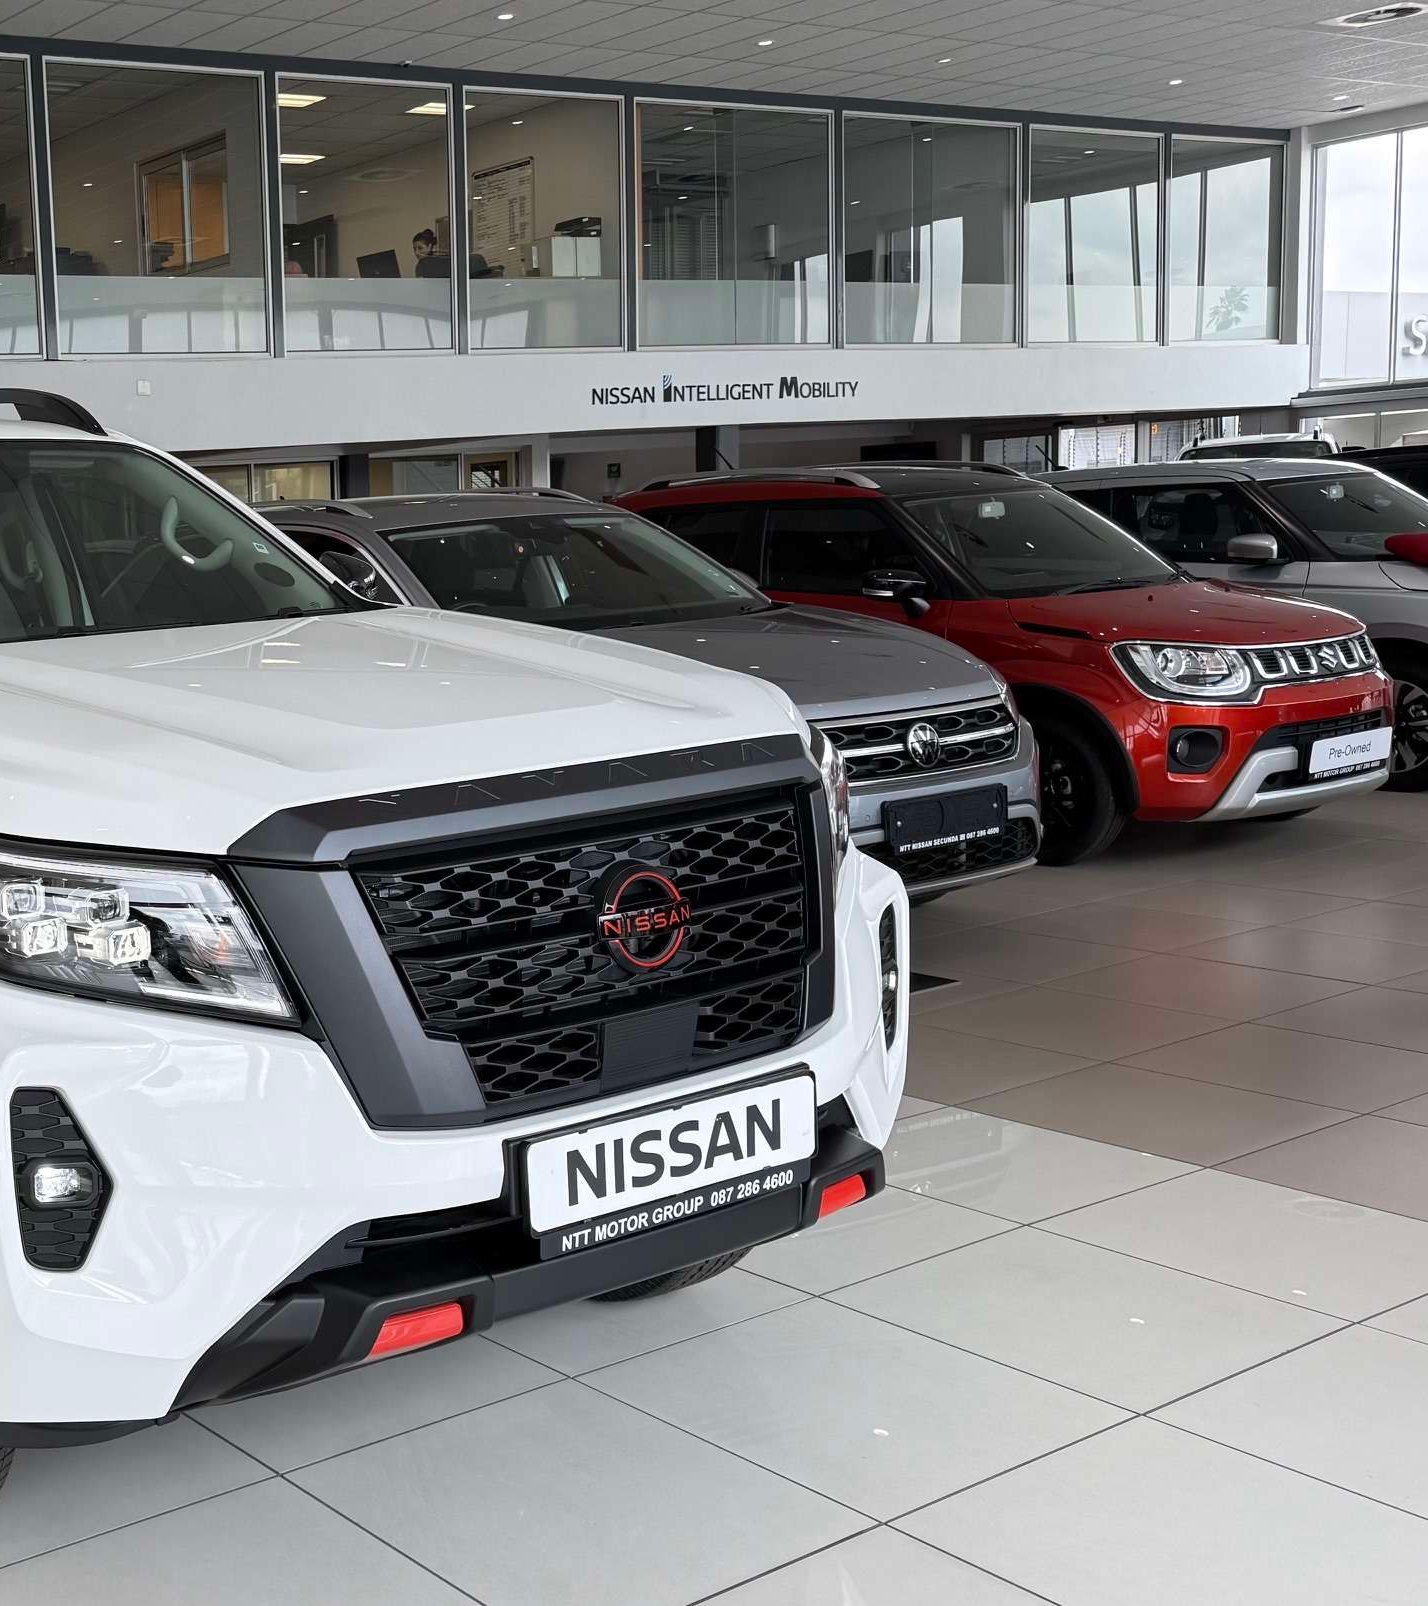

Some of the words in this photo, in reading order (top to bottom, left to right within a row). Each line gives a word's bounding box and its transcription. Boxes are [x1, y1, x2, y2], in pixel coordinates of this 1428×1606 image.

[591, 386, 656, 406] NISSAN
[778, 376, 859, 399] MOBILITY
[1328, 740, 1372, 760] Pre-Owned
[899, 844, 911, 853] NTT
[911, 840, 933, 850] NISSAN
[933, 835, 959, 846] SECUNDA
[603, 904, 690, 936] NISSAN
[566, 1098, 782, 1207] NISSAN
[561, 1228, 592, 1252] NTT
[594, 1213, 649, 1243] MOTOR
[652, 1196, 704, 1225] GROUP
[710, 1187, 734, 1207] 087
[737, 1179, 760, 1200] 286
[763, 1168, 794, 1191] 4600
